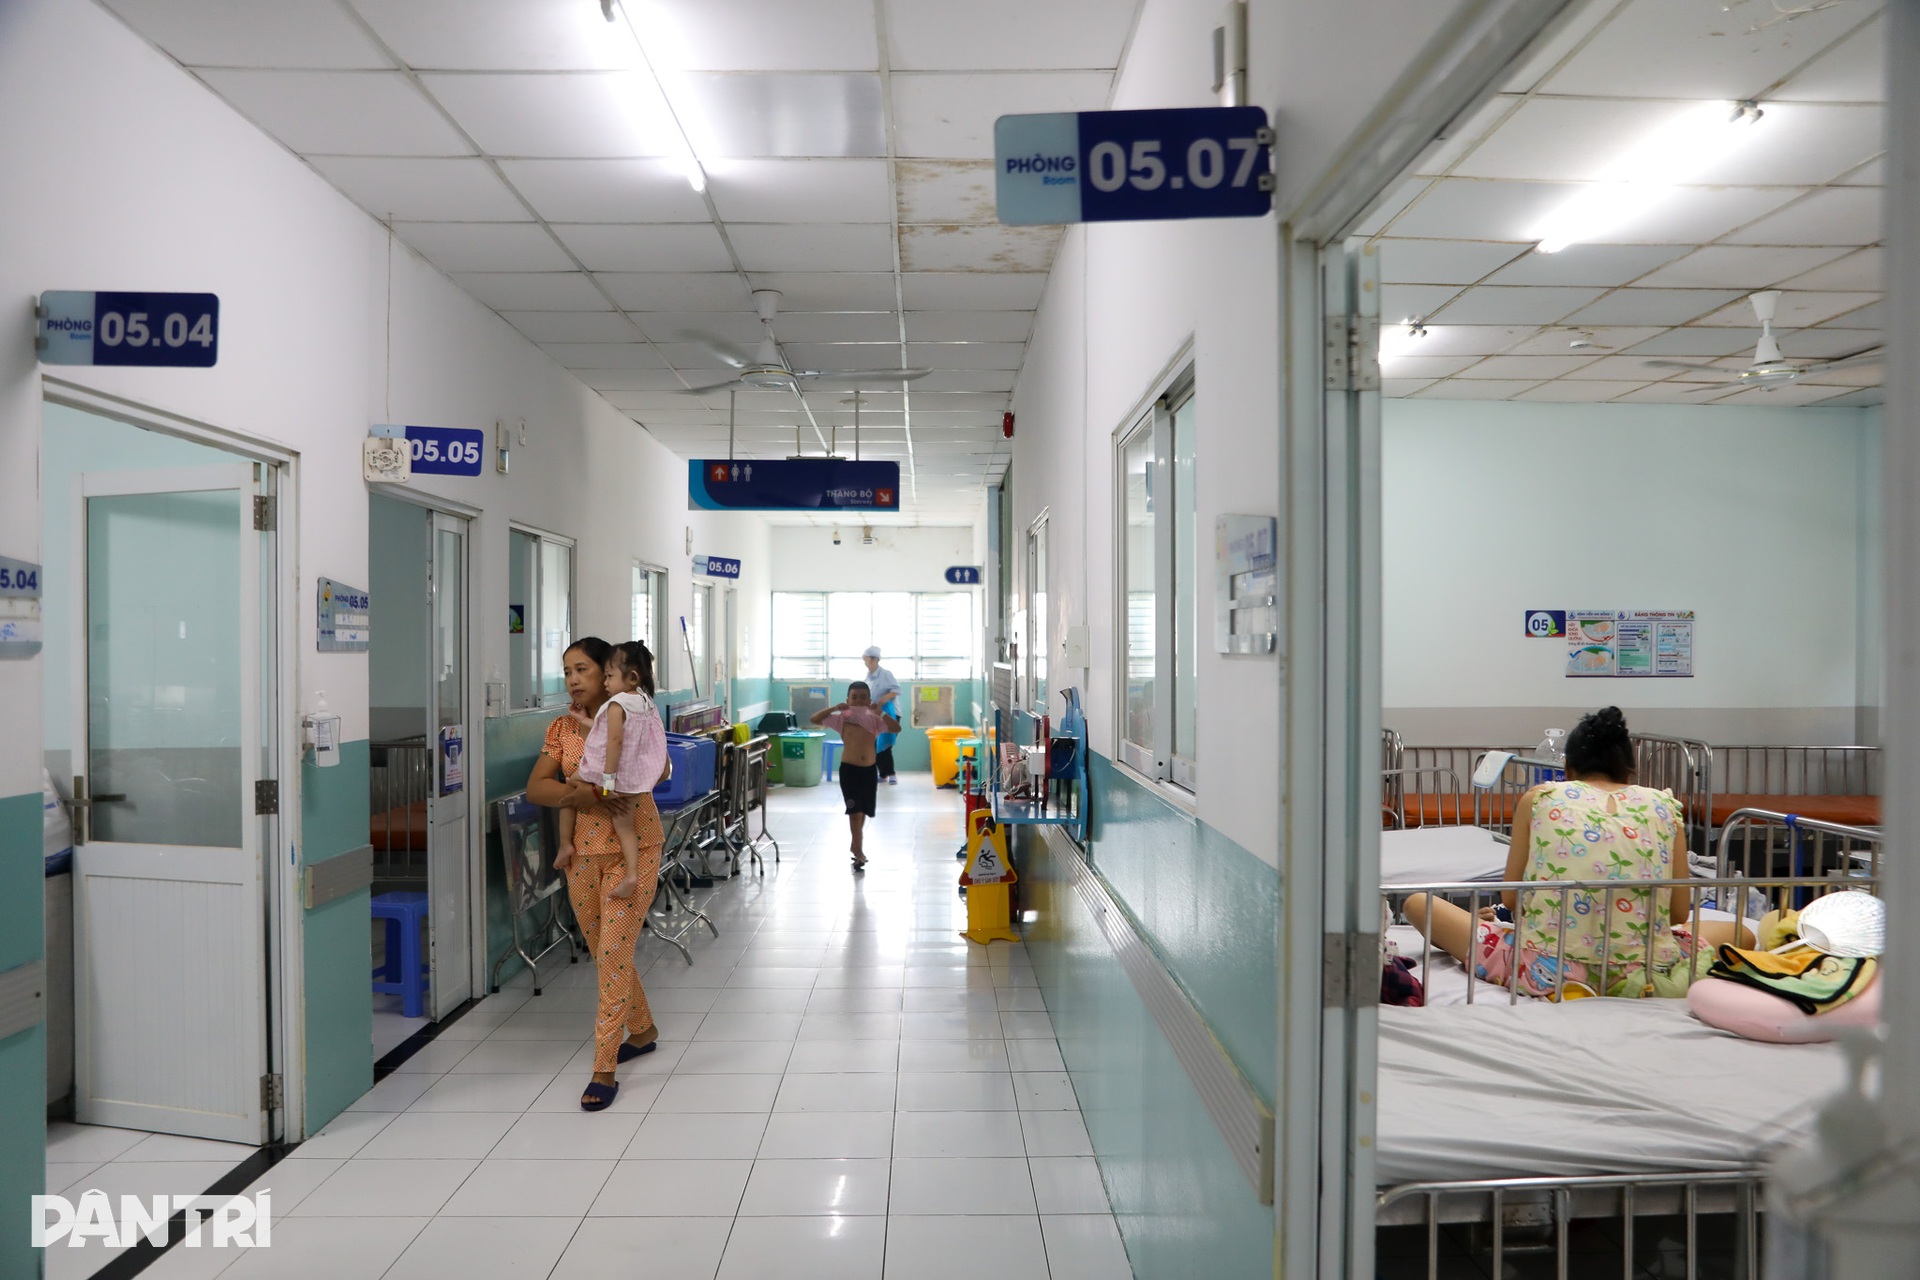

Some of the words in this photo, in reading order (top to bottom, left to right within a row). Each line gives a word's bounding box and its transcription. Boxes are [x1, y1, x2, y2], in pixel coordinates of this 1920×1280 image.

[1006, 152, 1076, 174] PHÒNG
[1088, 138, 1260, 193] 05.07
[1042, 175, 1076, 186] Room
[47, 317, 93, 331] PHÒNG
[100, 312, 214, 347] 05.04
[410, 438, 480, 465] 05.05
[826, 490, 857, 498] THANG
[860, 488, 873, 500] BỘ
[708, 561, 738, 574] 05.06
[349, 595, 369, 609] 05.05
[1532, 618, 1549, 631] 05
